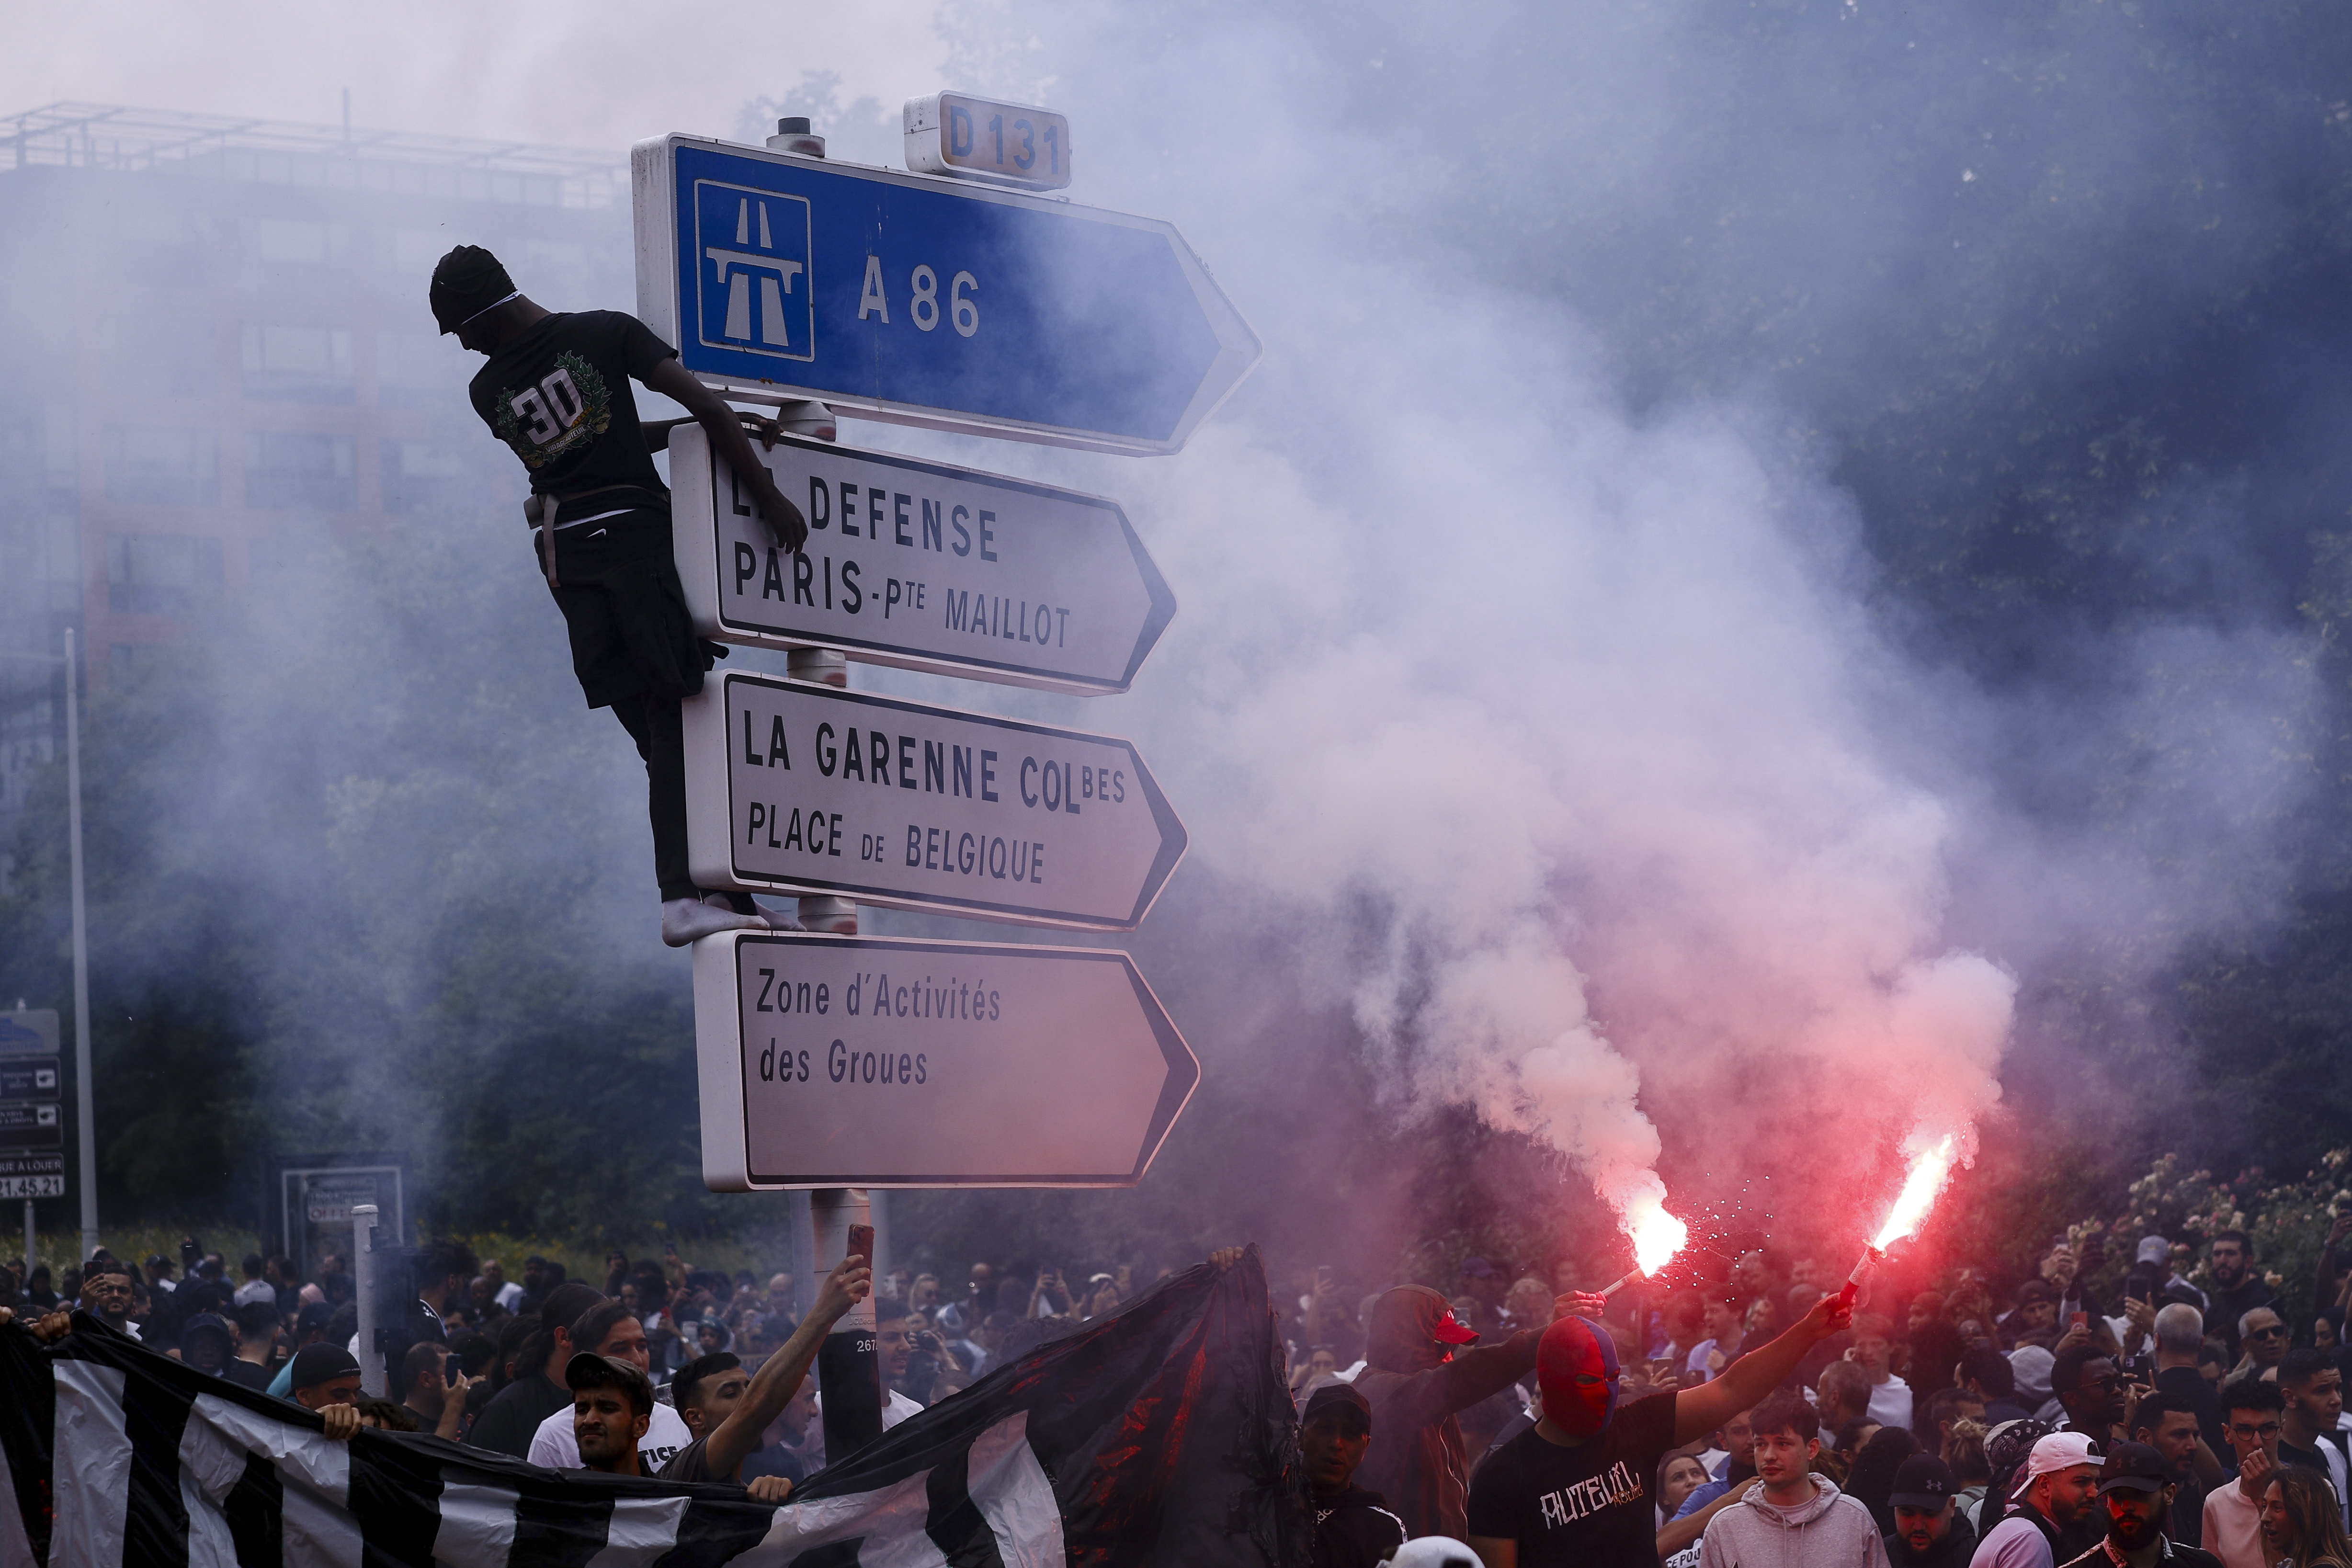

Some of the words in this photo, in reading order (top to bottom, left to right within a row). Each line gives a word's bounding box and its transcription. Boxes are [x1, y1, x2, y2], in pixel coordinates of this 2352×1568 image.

[950, 105, 974, 158] D
[989, 114, 1059, 176] 131
[858, 255, 889, 324] A
[910, 264, 979, 338] 86
[510, 367, 584, 445] 30
[731, 467, 774, 519] L
[809, 475, 998, 563] DEFENSE
[945, 588, 1070, 648] MAILLOT
[744, 709, 791, 770] LA
[815, 722, 999, 803] GARENNE
[748, 801, 843, 857] PLACE
[862, 833, 885, 864] DE
[906, 825, 1045, 885] BELGIQUE
[756, 968, 829, 1015] Zone
[846, 972, 1000, 1021] d'Activités
[760, 1037, 810, 1082] des
[828, 1038, 927, 1085] Groues
[18, 1161, 25, 1172] A
[27, 1159, 61, 1171] LOUER
